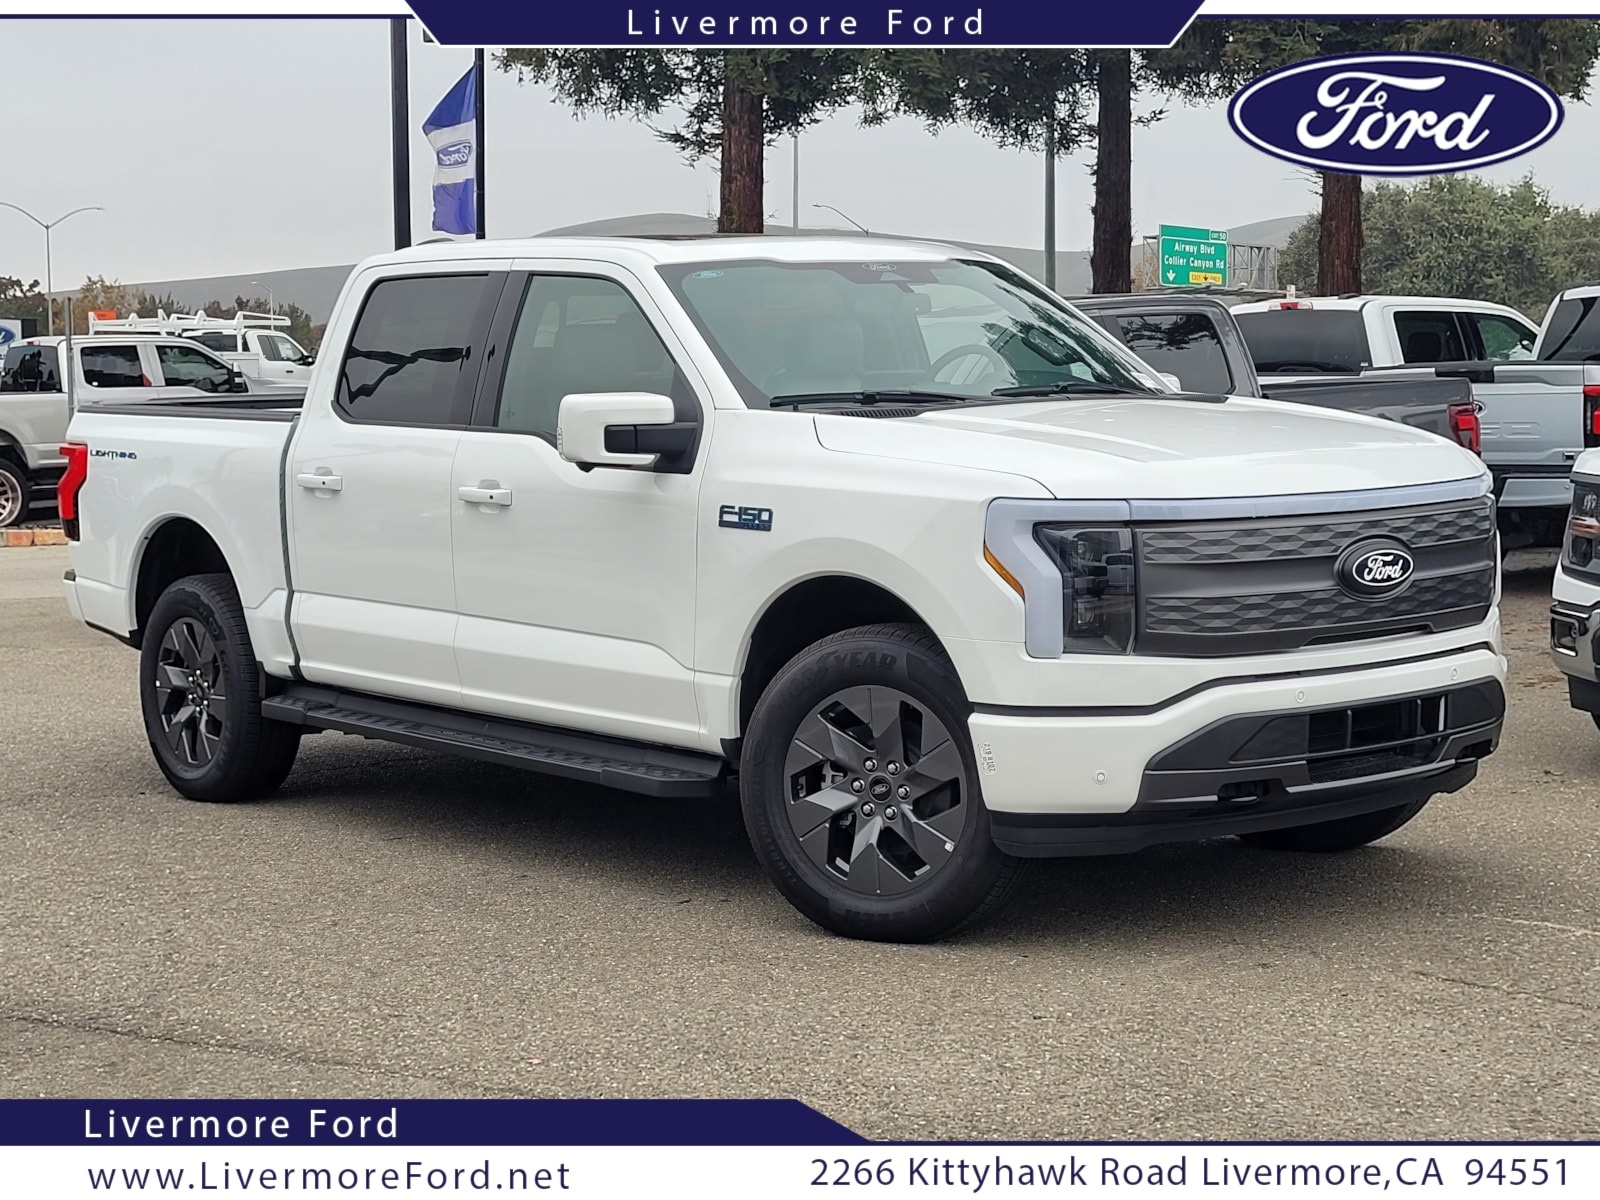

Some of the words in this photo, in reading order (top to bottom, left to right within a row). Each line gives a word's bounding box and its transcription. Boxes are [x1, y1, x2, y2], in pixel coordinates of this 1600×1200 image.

[1219, 232, 1226, 240] 50
[1174, 241, 1197, 255] Airway
[1200, 244, 1215, 254] Blvd
[1164, 255, 1186, 266] Collier
[1189, 257, 1213, 270] Canyon
[1215, 259, 1225, 269] Rd
[90, 449, 137, 460] LIGHTNING
[1364, 555, 1403, 580] Ford
